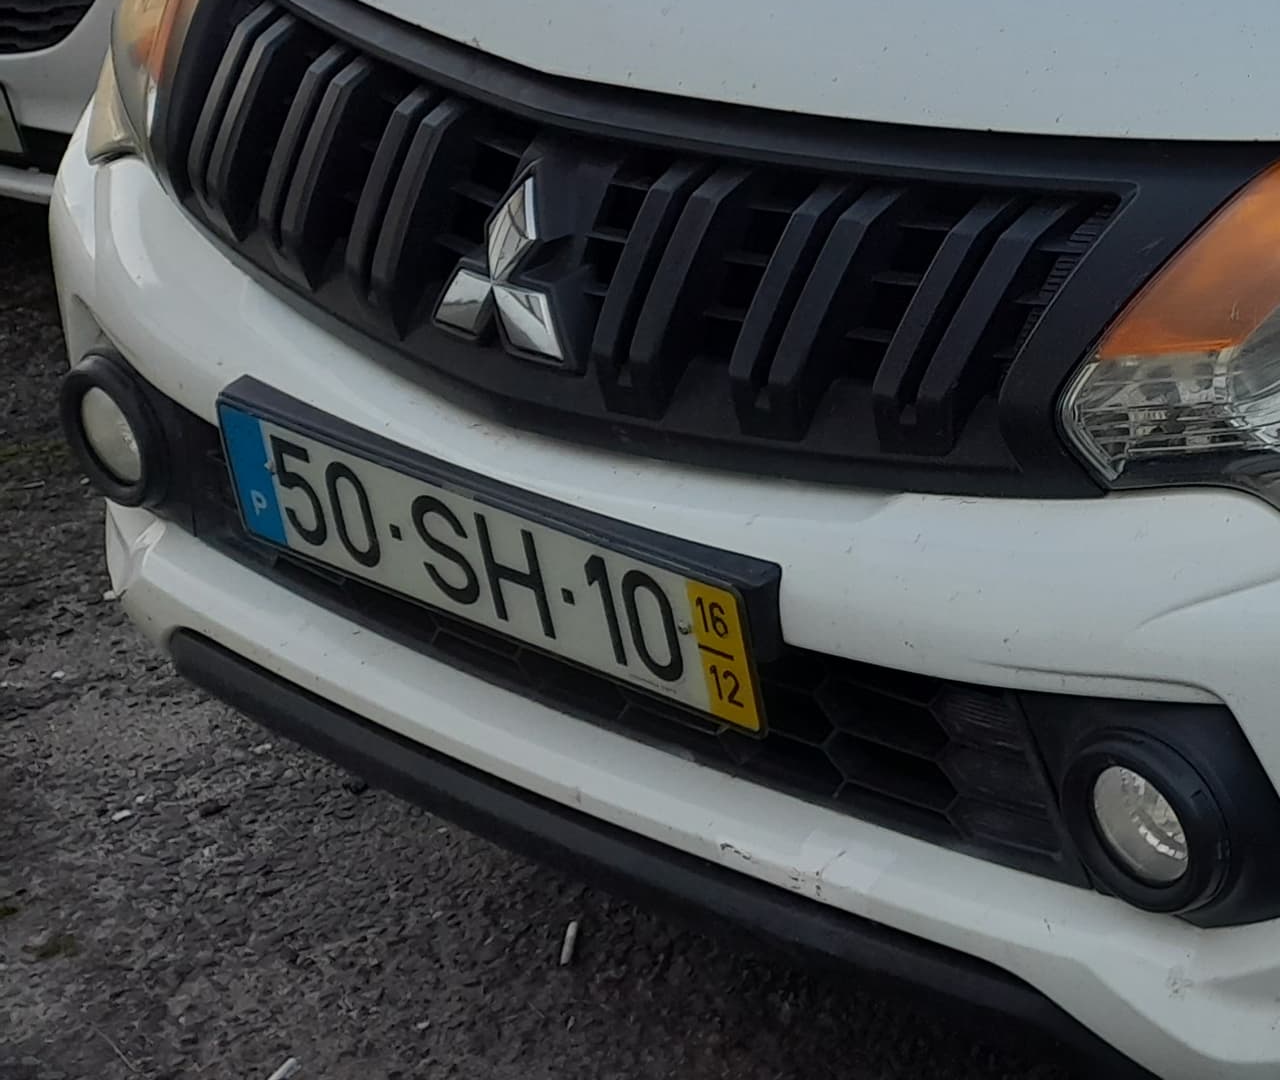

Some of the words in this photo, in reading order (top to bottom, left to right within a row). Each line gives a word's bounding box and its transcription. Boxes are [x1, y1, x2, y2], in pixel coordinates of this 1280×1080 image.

[250, 488, 269, 517] P
[696, 596, 729, 639] 16
[709, 664, 745, 708] 12
